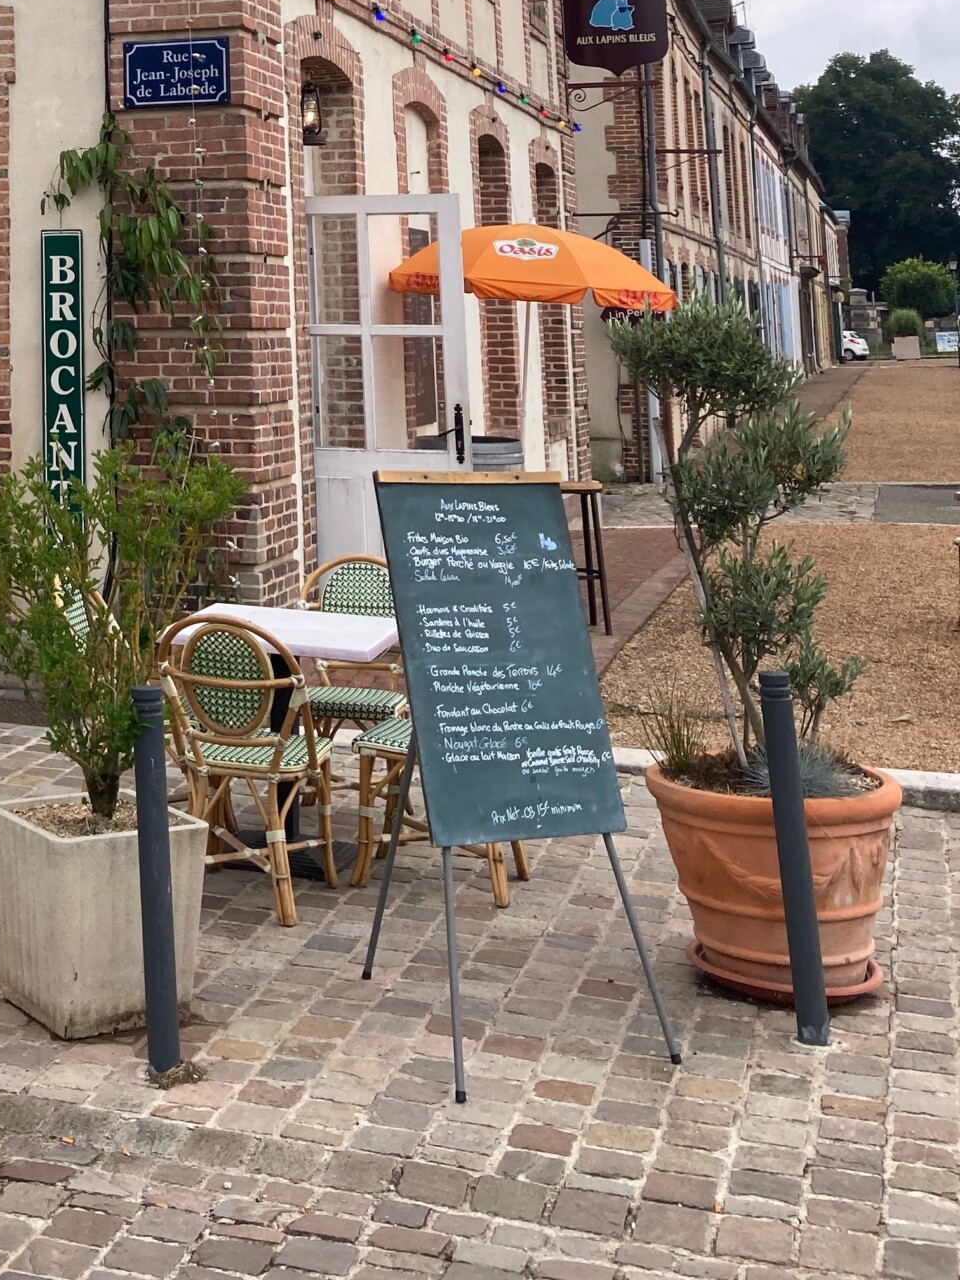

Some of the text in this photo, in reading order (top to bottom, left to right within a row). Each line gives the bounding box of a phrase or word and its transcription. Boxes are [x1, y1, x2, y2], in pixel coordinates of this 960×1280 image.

[577, 33, 656, 45] AUX LAPINS BLEUS
[163, 50, 189, 63] Rue
[133, 65, 219, 85] Jean-Joseph
[137, 82, 217, 97] de Labode
[499, 244, 553, 257] Oasis
[609, 310, 625, 320] Lin
[49, 255, 77, 549] BROCANT
[430, 532, 454, 545] Maison
[455, 534, 469, 544] Bio
[413, 556, 443, 570] Burger
[478, 562, 488, 570] ou
[460, 603, 494, 614] Crudités
[503, 602, 517, 613] 5€
[423, 617, 454, 628] Sardines
[507, 616, 519, 628] 5€
[453, 629, 462, 639] de
[465, 629, 490, 639] Poisson
[509, 626, 522, 638] 5€
[425, 642, 441, 653] Duo
[453, 643, 489, 653] Saucisson
[510, 641, 522, 653] 6€
[431, 665, 461, 677] Grande
[492, 667, 506, 679] des
[506, 664, 539, 678] Terroirs
[433, 681, 464, 694] Planche
[436, 699, 534, 719] Fondant au Chocolat 6€
[439, 722, 469, 736] Fromage
[470, 722, 491, 733] blanc
[492, 722, 503, 733] du
[444, 736, 478, 753] Nougat
[515, 736, 529, 749] 6€
[481, 751, 496, 761] lait
[506, 806, 521, 822] Net
